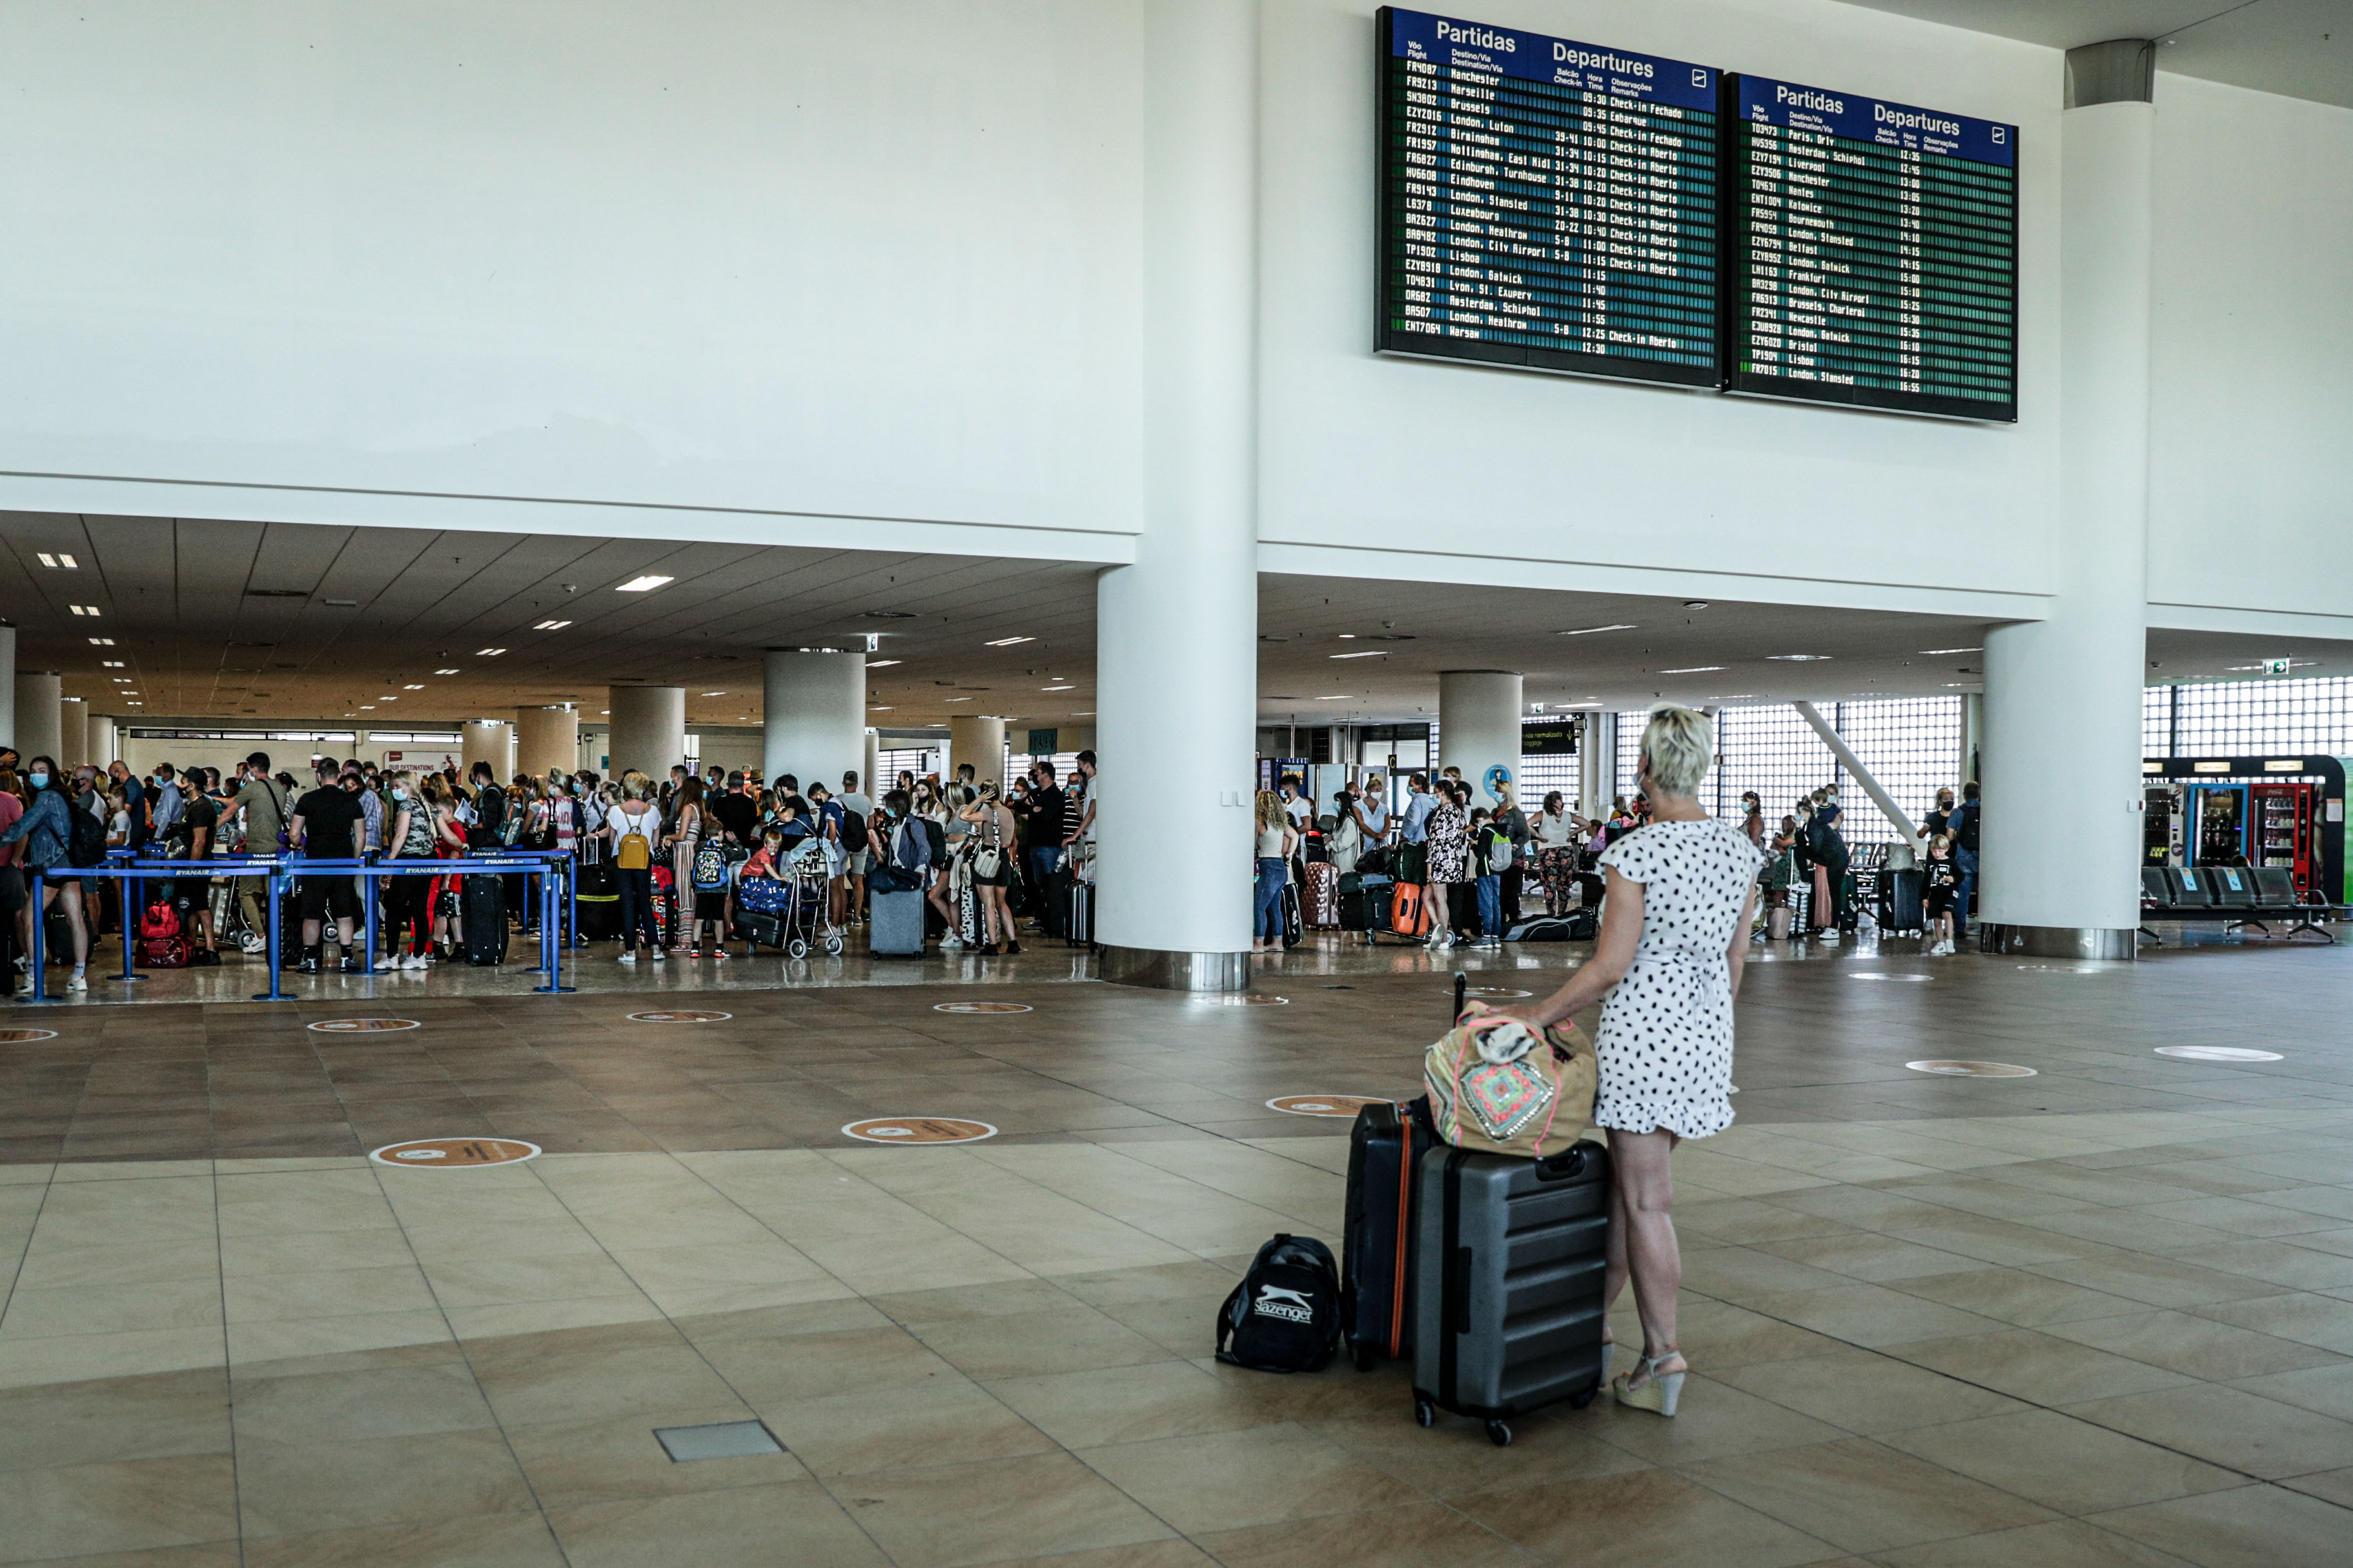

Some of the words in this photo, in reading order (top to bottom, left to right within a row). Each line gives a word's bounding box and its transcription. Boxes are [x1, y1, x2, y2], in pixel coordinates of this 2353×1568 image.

[1437, 21, 1515, 53] Partidas
[1554, 43, 1653, 78] Departures
[1408, 49, 1427, 60] Flight
[1452, 58, 1503, 73] Destination/Via
[1554, 75, 1582, 87] Check-in
[1588, 81, 1603, 91] Time
[1611, 86, 1638, 97] Remarks
[1452, 49, 1491, 63] Destino/Via
[1587, 73, 1602, 83] Hora
[1407, 75, 1437, 90] FR9213
[1451, 83, 1495, 100] Marseille
[1583, 106, 1606, 120] 09:35
[1610, 111, 1647, 126] Embarque
[1451, 68, 1499, 86] Manchester
[1583, 91, 1606, 105] 09:30
[1610, 96, 1647, 112] Check-in
[1650, 103, 1682, 119] Fechado
[1450, 98, 1490, 114] Brussels
[1583, 121, 1606, 134] 09:45
[1610, 125, 1647, 141] Check-in
[1650, 132, 1681, 147] Fechado
[1778, 85, 1843, 114] Partidas
[1875, 104, 1959, 135] Departures
[1790, 111, 1822, 123] Destino/Via
[1407, 105, 1442, 121] EZY2016
[1451, 113, 1484, 129] London,
[1489, 120, 1514, 133] Luton
[1555, 131, 1578, 144] 39-41
[1583, 136, 1606, 149] 10:00
[1610, 140, 1647, 156] Check-in
[1650, 147, 1677, 161] Aberto
[1407, 121, 1437, 136] FR2912
[1450, 127, 1499, 146] Birmingham
[1555, 145, 1578, 159] 31-34
[1583, 150, 1606, 164] 10:15
[1752, 113, 1769, 122] Flight
[1790, 119, 1833, 133] Destination/Via
[1875, 135, 1899, 145] Check-in
[1903, 140, 1917, 149] Time
[1924, 144, 1947, 154] Remarks
[1817, 134, 1834, 146] Orly
[1901, 150, 1920, 161] 12:35
[1406, 136, 1437, 150] FR1957
[1450, 143, 1503, 161] Nottingham,
[1508, 152, 1527, 165] East
[1532, 156, 1550, 169] Midl
[1555, 160, 1579, 173] 31-34
[1583, 165, 1606, 178] 10:20
[1833, 151, 1865, 166] Schiphol
[1450, 158, 1498, 176] Edinburgh,
[1504, 167, 1546, 183] Turnhouse
[1610, 183, 1646, 199] Check-in
[1650, 190, 1677, 204] Aberto
[1450, 173, 1494, 190] Eindhoven
[1555, 190, 1573, 202] 9-11
[1789, 157, 1825, 172] Liverpool
[1900, 177, 1920, 188] 13:00
[1789, 171, 1830, 186] Manchester
[1406, 182, 1437, 197] FR9143
[1450, 188, 1484, 203] London,
[1489, 195, 1527, 210] Stansted
[1583, 210, 1606, 222] 10:30
[1789, 185, 1814, 198] Nantes
[1900, 204, 1919, 216] 13:20
[1789, 199, 1822, 213] Katowice
[1406, 213, 1436, 227] BA2627
[1450, 219, 1484, 234] London,
[1489, 224, 1527, 240] Heathrow
[1583, 239, 1606, 252] 11:00
[1450, 204, 1499, 221] Luxembourg
[1555, 219, 1578, 233] 20-22
[1583, 224, 1606, 237] 10:40
[1610, 228, 1647, 243] Check-in
[1650, 234, 1677, 247] Aberto
[1789, 213, 1833, 229] Bournemouth
[1900, 231, 1919, 243] 14:10
[1821, 232, 1853, 246] Stansted
[1406, 243, 1435, 258] TP1902
[1450, 249, 1479, 263] Lisboa
[1450, 234, 1484, 249] London,
[1489, 239, 1508, 252] City
[1512, 243, 1545, 258] Airport
[1583, 253, 1606, 266] 11:15
[1610, 257, 1646, 272] Check-in
[1649, 263, 1677, 276] Aberto
[1789, 241, 1817, 255] Belfast
[1900, 259, 1920, 270] 14:15
[1821, 260, 1850, 273] Gatwick
[1449, 279, 1474, 293] Lyon,
[1479, 283, 1493, 295] St.
[1498, 286, 1532, 300] Exupery
[1582, 297, 1606, 310] 11:45
[1450, 264, 1483, 279] London,
[1488, 269, 1522, 284] Gatwick
[1583, 283, 1606, 295] 11:40
[1789, 269, 1825, 284] Frankfurt
[1901, 286, 1920, 298] 15:10
[1449, 295, 1498, 311] Amsterdam,
[1503, 302, 1540, 316] Schiphol
[1582, 312, 1605, 325] 11:55
[1821, 288, 1837, 299] City
[1841, 291, 1869, 304] Airport
[1405, 304, 1430, 318] BA507
[1449, 310, 1483, 324] London,
[1488, 315, 1527, 329] Heathrow
[1582, 327, 1605, 340] 12:25
[1609, 330, 1646, 344] Check-in
[1649, 335, 1677, 349] Aberto
[1789, 311, 1826, 325] Newcastle
[1829, 303, 1865, 317] Charleroi
[1900, 313, 1919, 325] 15:30
[1405, 320, 1440, 334] ENT7064
[1449, 325, 1479, 339] Warsaw
[1582, 341, 1605, 354] 12:30
[1789, 339, 1817, 353] Bristol
[1821, 329, 1850, 343] Gatwick
[1900, 340, 1919, 352] 16:10
[1789, 354, 1814, 366] Lisboa
[1900, 367, 1919, 379] 16:20
[1821, 371, 1853, 385] Stansted
[1389, 757, 1395, 769] C
[1255, 1300, 1312, 1321] Slazenger
